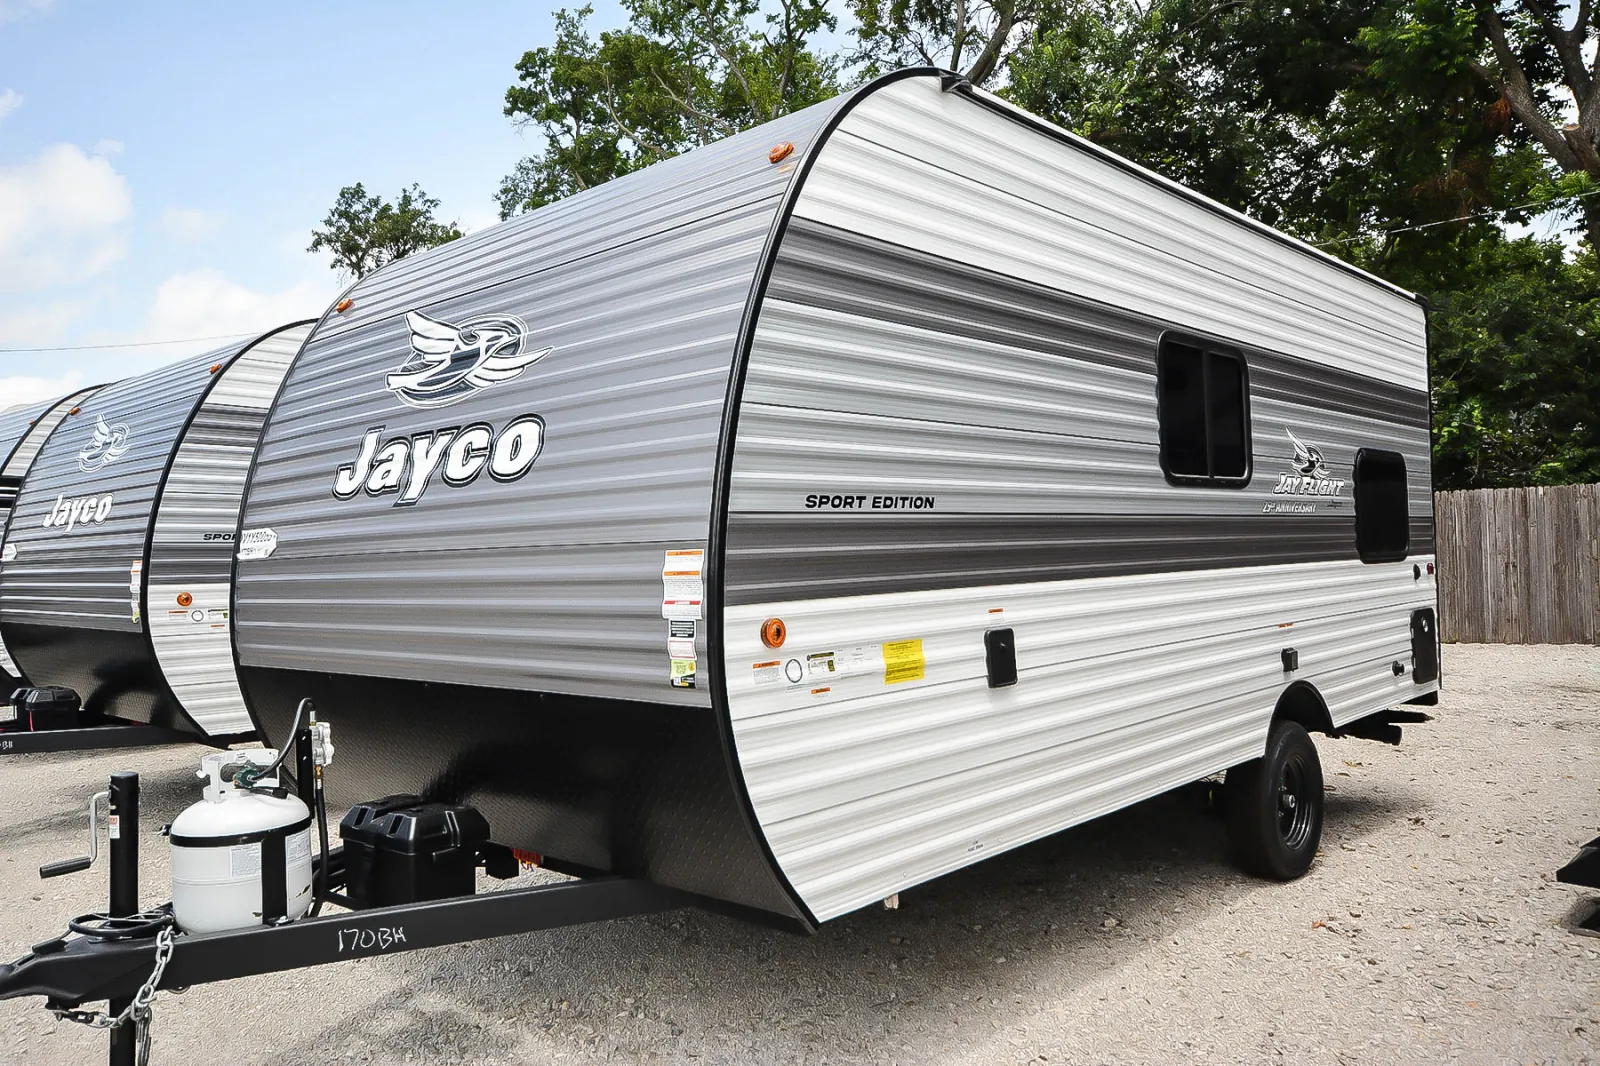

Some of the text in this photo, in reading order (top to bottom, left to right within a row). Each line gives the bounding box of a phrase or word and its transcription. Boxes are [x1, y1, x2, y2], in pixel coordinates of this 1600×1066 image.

[332, 413, 546, 507] Jayco
[1272, 473, 1345, 496] JAY FLIGHT
[42, 492, 114, 535] Jayco
[805, 494, 935, 509] SPORT EDITION
[338, 926, 407, 952] 170BH
